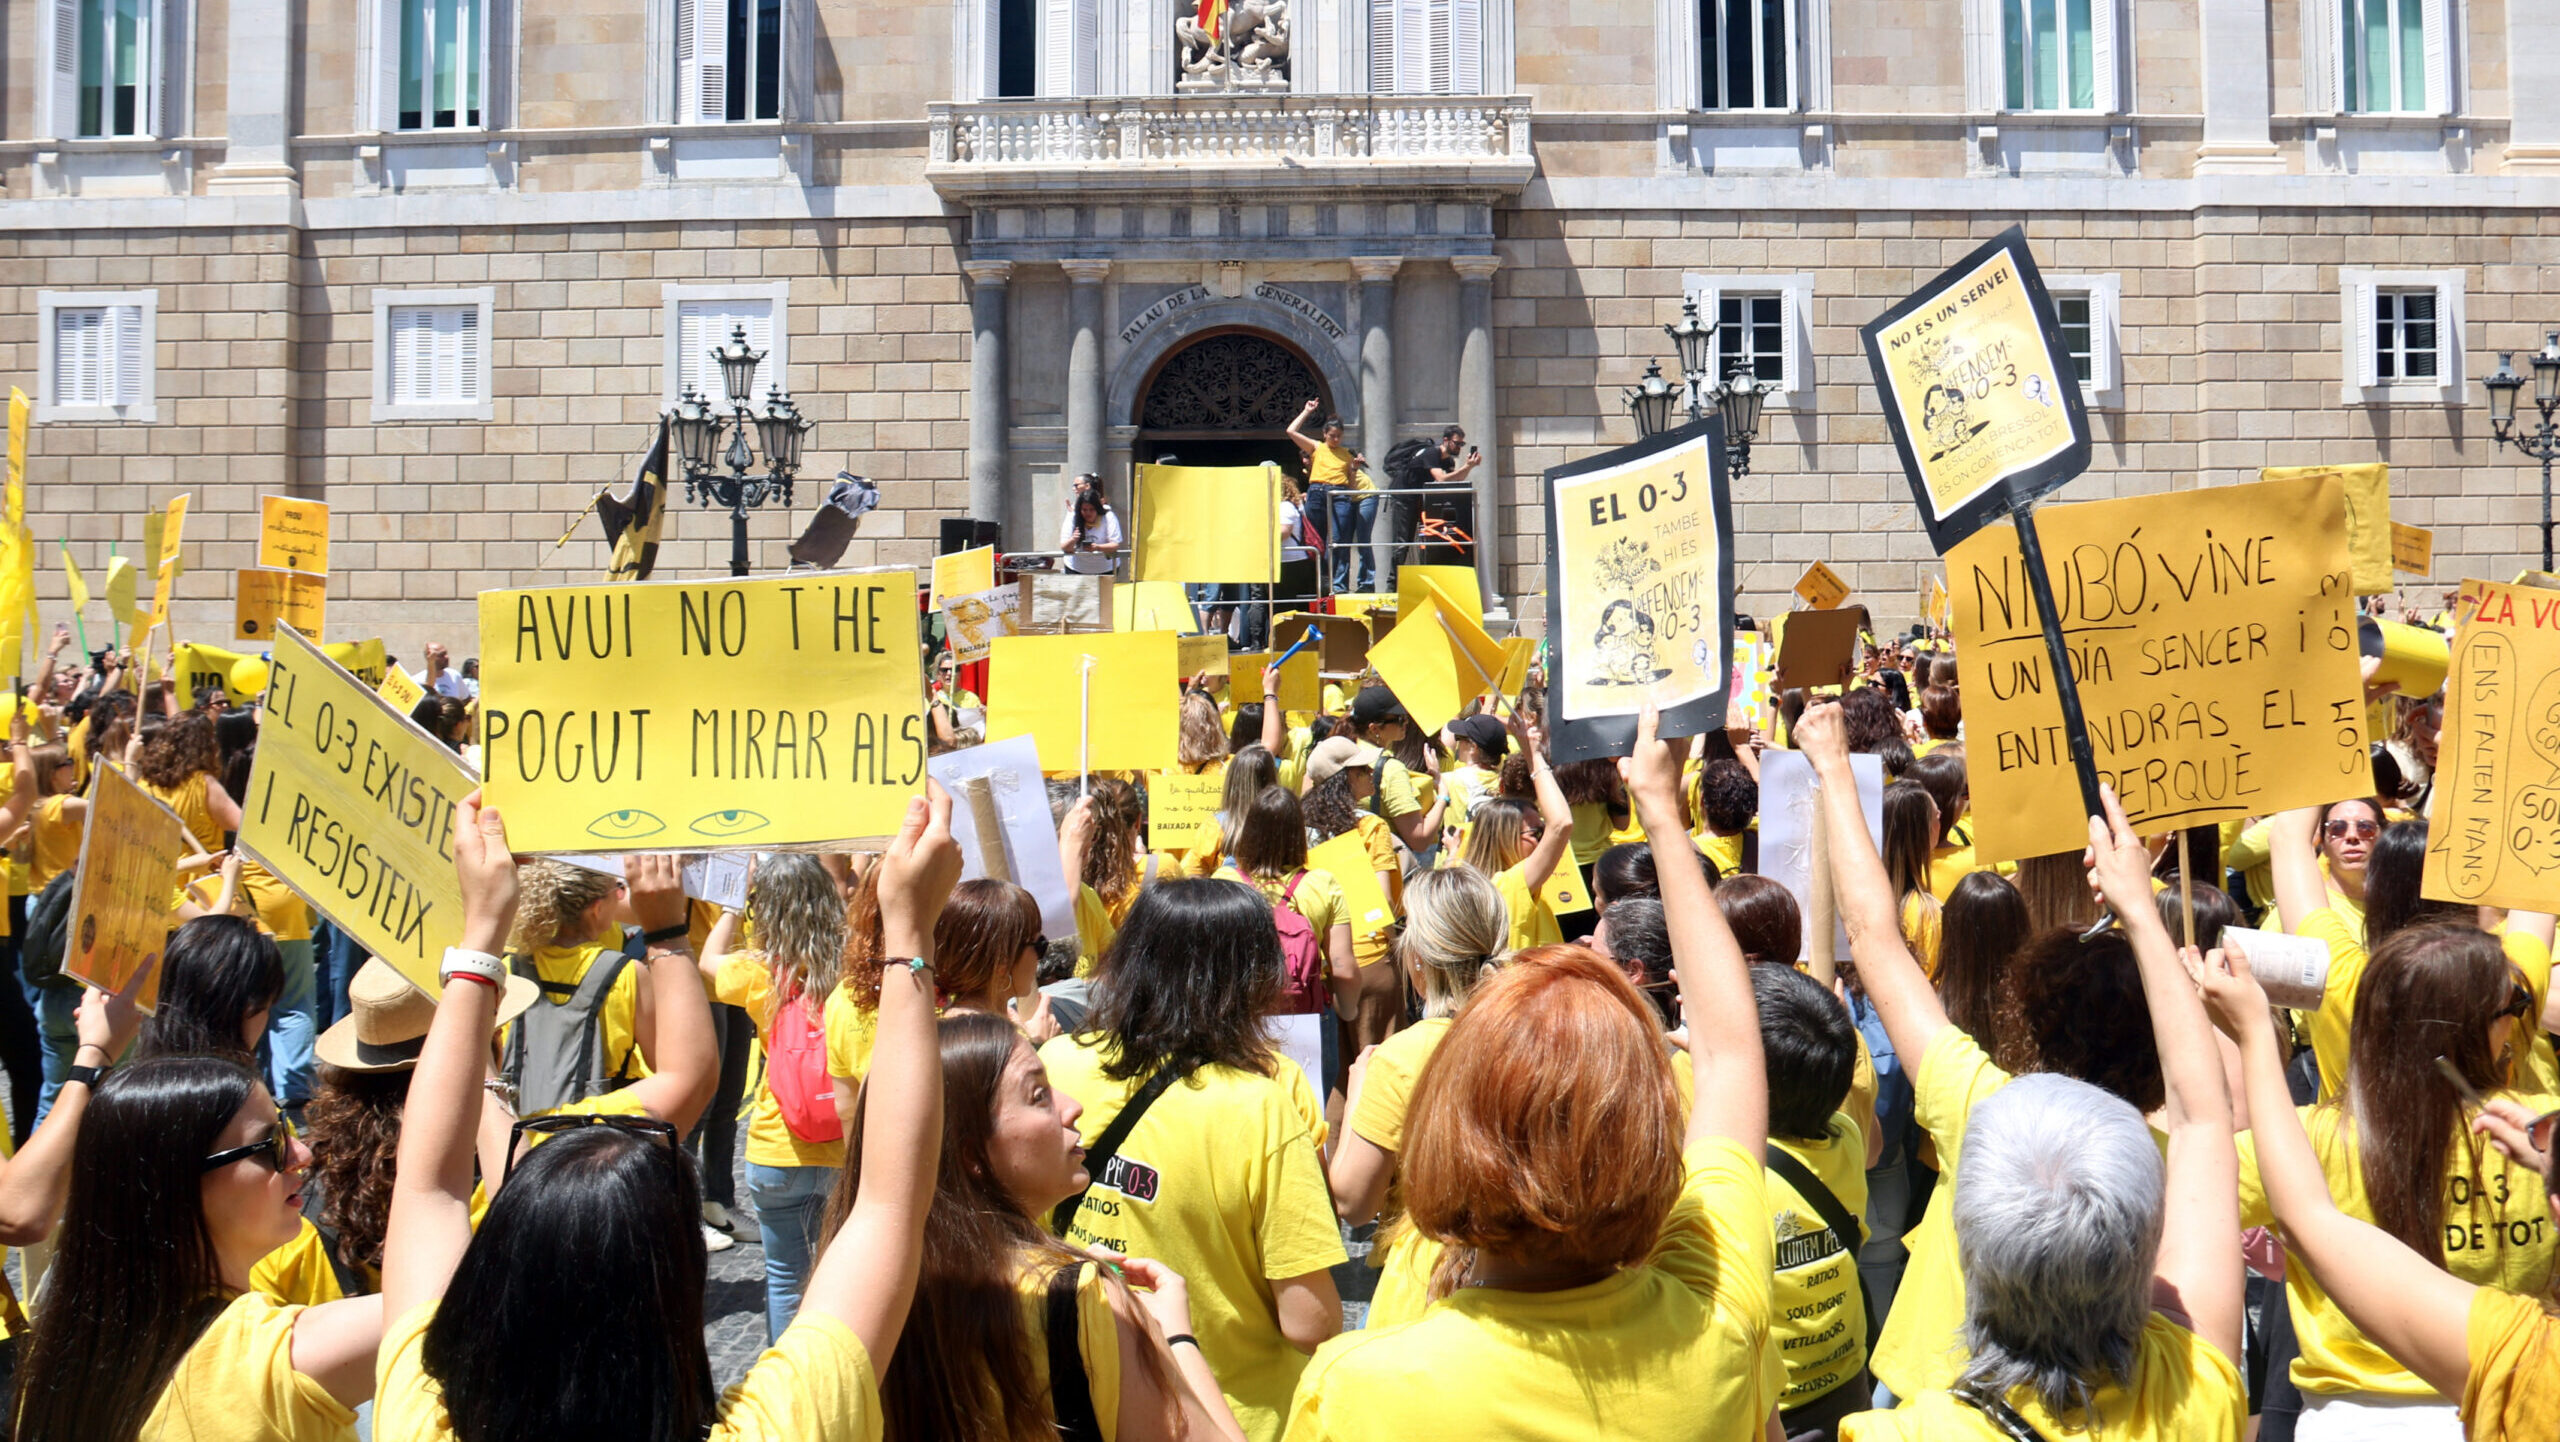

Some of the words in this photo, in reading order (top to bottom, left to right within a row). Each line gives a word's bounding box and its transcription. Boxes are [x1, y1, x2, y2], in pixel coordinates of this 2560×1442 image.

[1122, 305, 1164, 344] PALAU
[1167, 292, 1188, 311] DE
[1195, 286, 1211, 299] LA
[1255, 284, 1345, 341] GENERALITAT
[1890, 331, 1911, 351] NO
[1936, 302, 1958, 323] UN
[1960, 267, 2009, 307] SERVEI
[1976, 364, 2017, 400] 0-3
[1989, 409, 2050, 442] BRESSOL
[1952, 471, 1969, 487] ON
[1971, 436, 2035, 474] COMENÇA
[2038, 420, 2061, 438] TOT
[1589, 493, 1627, 526] EL
[1638, 471, 1687, 513] 0-3
[1664, 547, 1678, 562] HI
[516, 593, 632, 663] AVUI
[680, 589, 747, 657] NO
[1665, 604, 1701, 640] 0-3
[2321, 571, 2351, 651] 0-3
[2475, 589, 2516, 626] LA
[191, 671, 224, 690] NO
[1989, 656, 2041, 701] UN
[2140, 622, 2268, 677] SENCER
[2472, 644, 2501, 702] ENS
[266, 661, 296, 729] EL
[316, 701, 358, 774] 0-3
[1997, 693, 2228, 772] ENTNDRÀS
[2263, 689, 2306, 731] EL
[2330, 698, 2366, 775] SOM
[483, 709, 651, 783] POGUT
[692, 708, 828, 780] MIRAR
[852, 713, 924, 786] ALS
[2473, 714, 2496, 804] FALTEN
[1185, 782, 1223, 800] qualitat
[1157, 822, 1191, 830] BAIXADA
[260, 771, 275, 825] I
[287, 792, 433, 958] RESISTEIX
[1128, 1166, 1156, 1199] 0-3
[2451, 1174, 2510, 1206] 0-3
[2445, 1222, 2485, 1252] DE
[2493, 1215, 2545, 1248] TOT
[1806, 1265, 1840, 1289] RATIOS
[1783, 1319, 1846, 1351] VETLLADORS
[1786, 1303, 1815, 1321] SOUS
